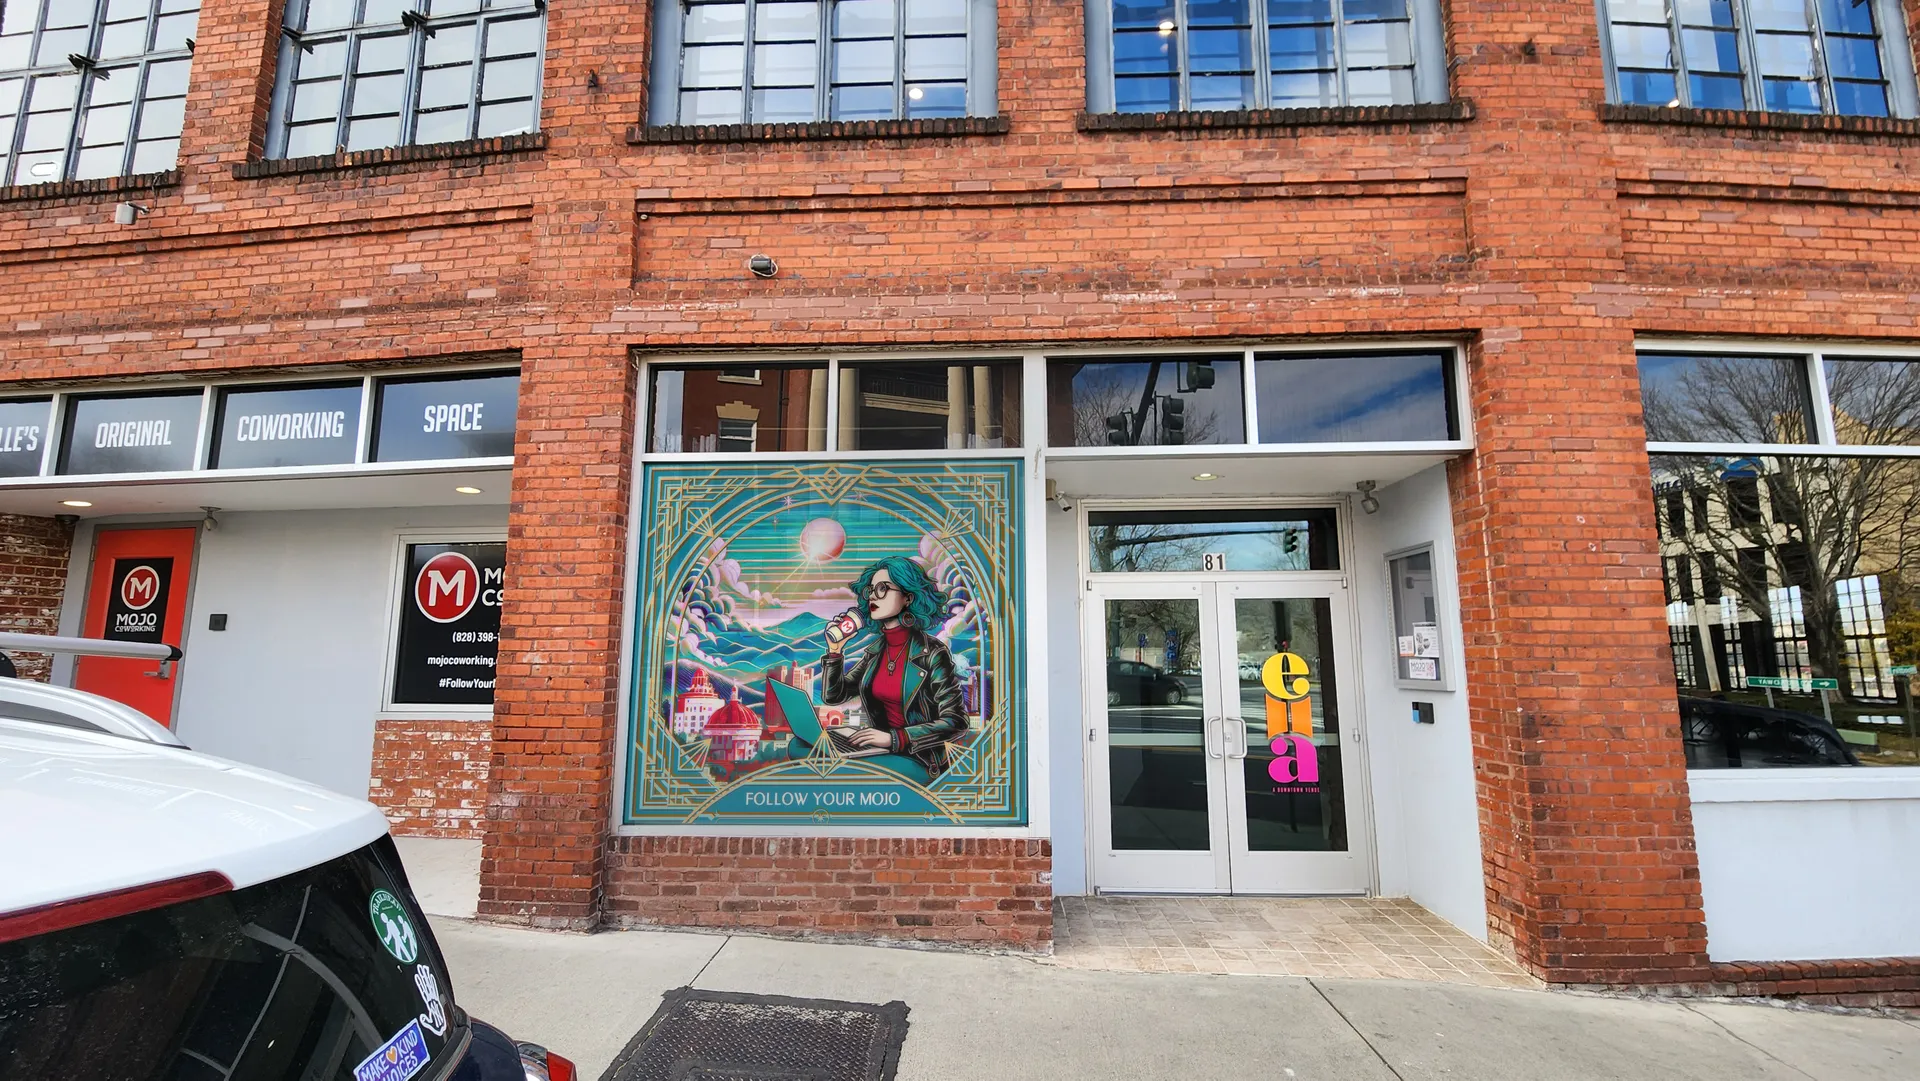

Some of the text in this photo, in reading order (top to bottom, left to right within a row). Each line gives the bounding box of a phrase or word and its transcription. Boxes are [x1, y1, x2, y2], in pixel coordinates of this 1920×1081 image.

[95, 420, 171, 448] ORIGINAL
[237, 411, 344, 441] COWORKING
[423, 403, 484, 432] SPACE
[1204, 554, 1223, 571] 81
[484, 568, 505, 584] M
[129, 577, 152, 599] M
[428, 570, 466, 606] M
[116, 613, 157, 626] MOJO
[453, 631, 476, 643] (828)
[428, 655, 498, 667] mojocoworking.
[745, 792, 900, 806] FOLLOW YOUR MOJO
[361, 1030, 418, 1081] MAKE KIND
